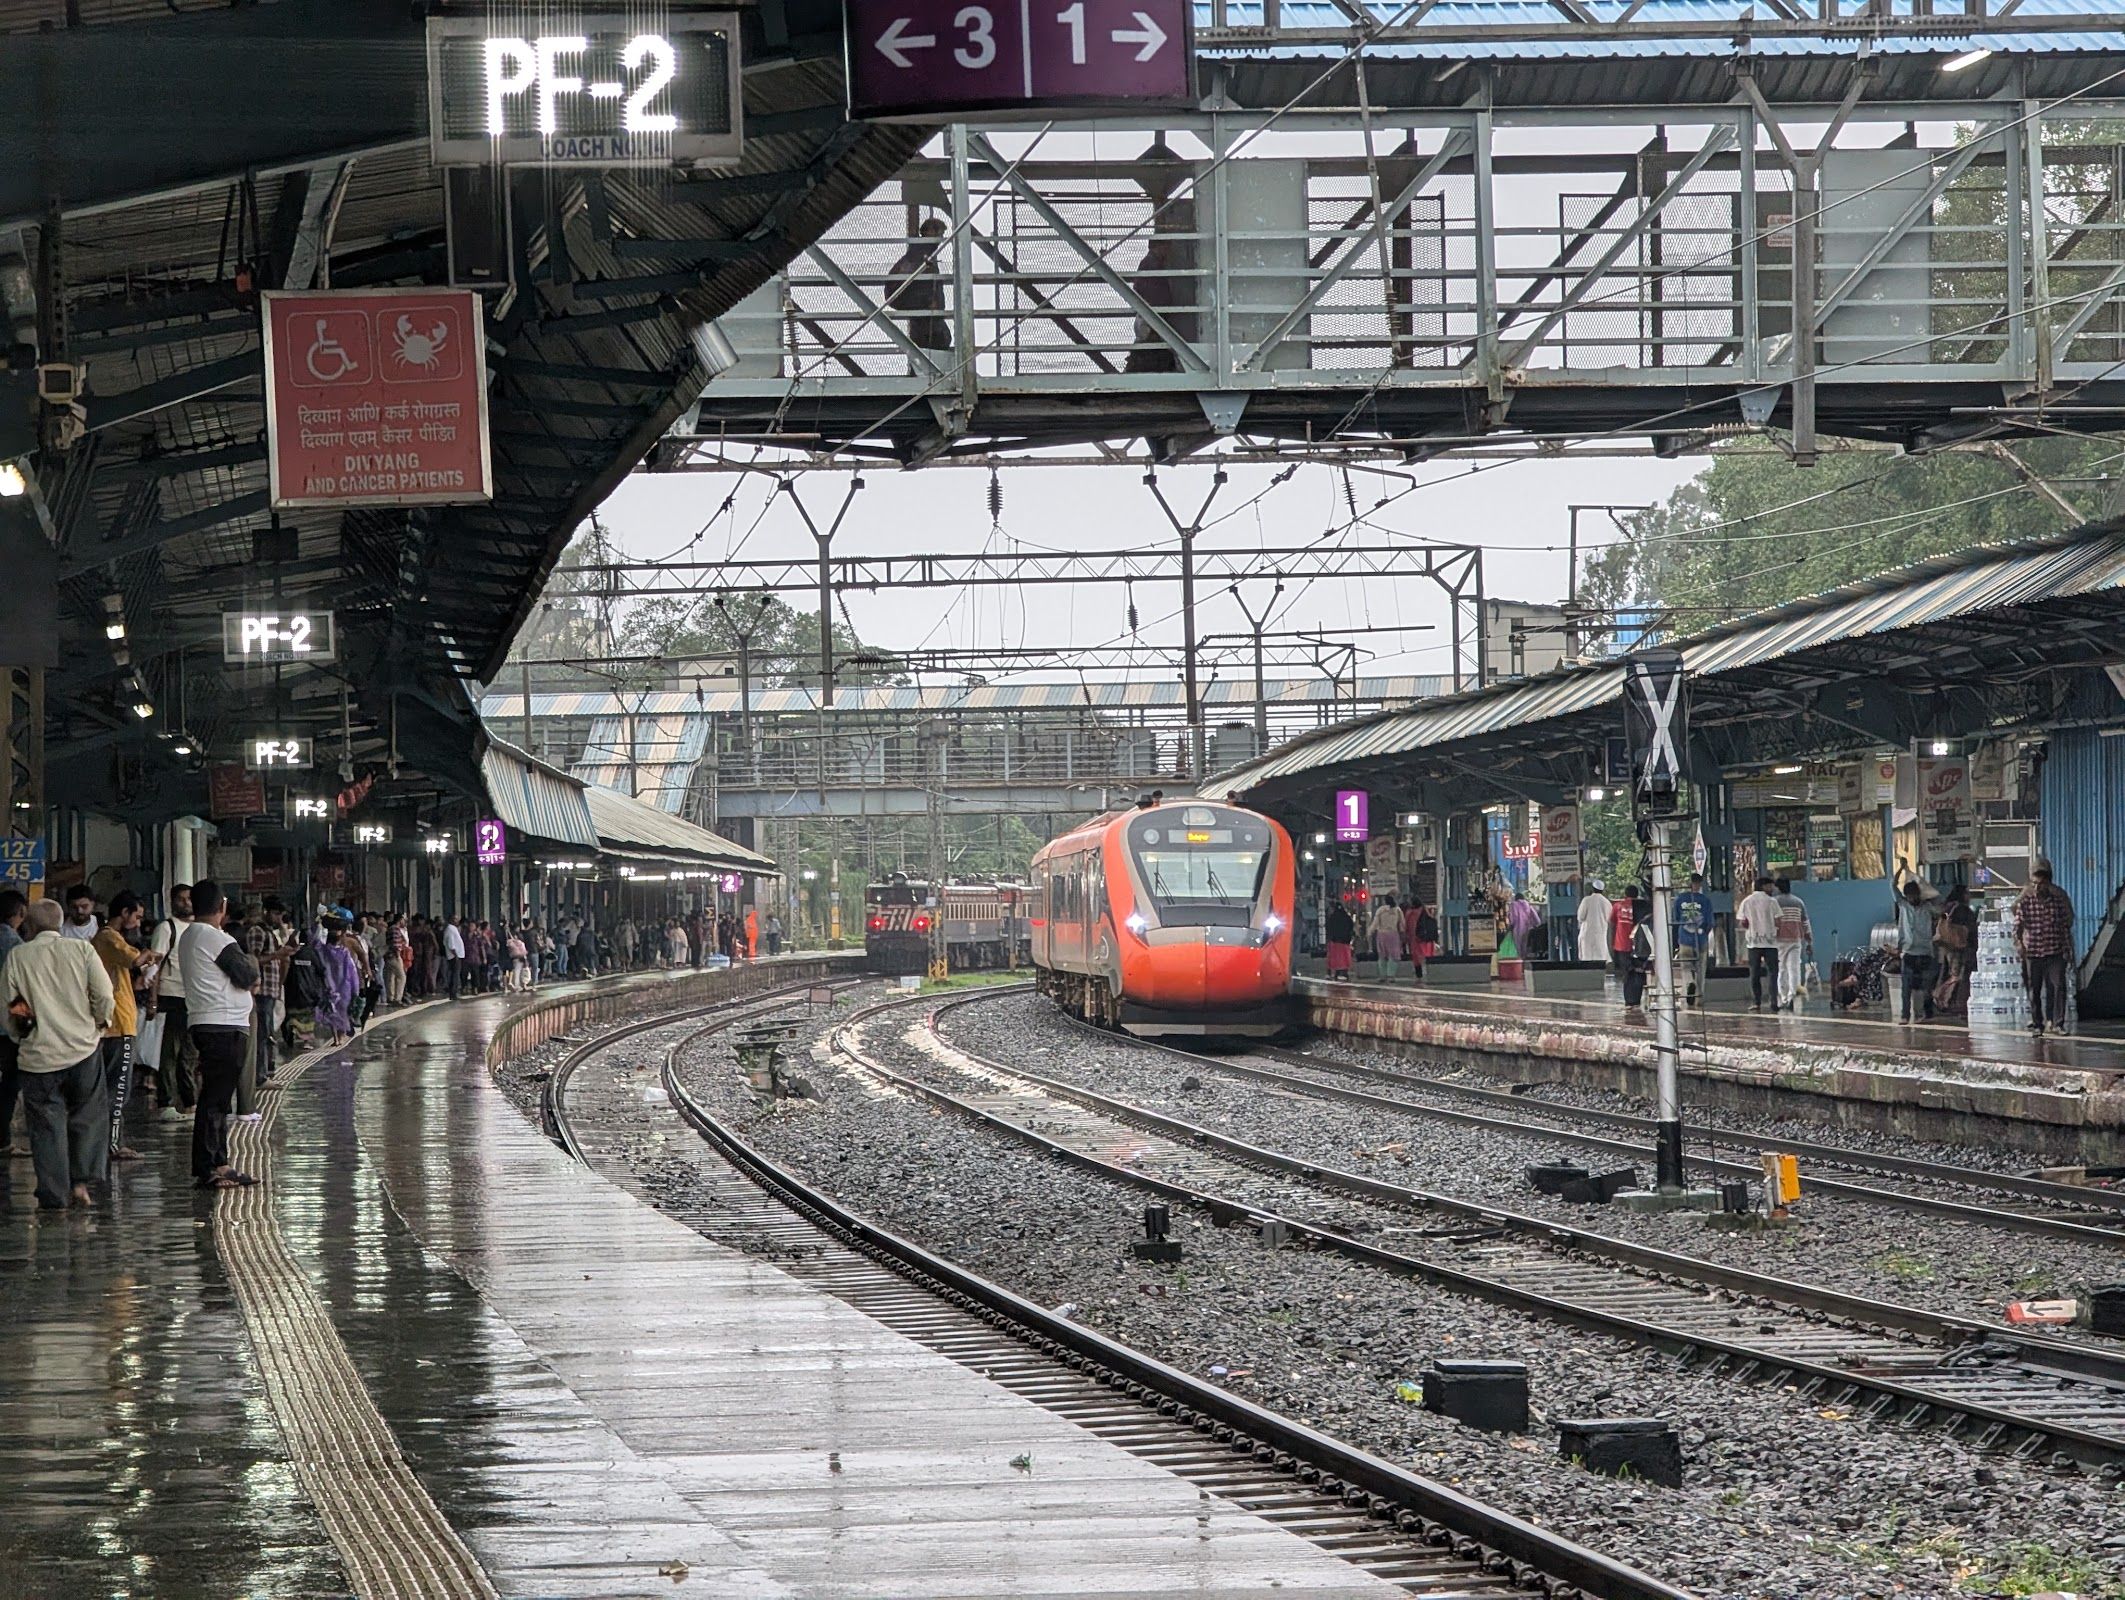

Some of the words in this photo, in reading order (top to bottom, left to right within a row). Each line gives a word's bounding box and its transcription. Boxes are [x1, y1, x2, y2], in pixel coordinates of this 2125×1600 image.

[954, 6, 996, 69] 3
[1057, 3, 1086, 64] 1
[485, 34, 677, 135] PF-2
[541, 137, 604, 158] COACH
[346, 402, 380, 422] आणि
[385, 400, 409, 421] कर्क
[348, 431, 380, 449] एवम्
[345, 453, 420, 472] DIVYANG
[306, 476, 335, 494] AND
[340, 473, 396, 492] CANCER
[400, 470, 464, 488] PATIENTS
[242, 616, 311, 653] PF-2
[255, 741, 300, 765] PF-2
[295, 799, 328, 817] PF-2
[1344, 795, 1359, 825] 1
[359, 826, 385, 842] PF-2
[480, 824, 501, 851] 2
[1, 841, 37, 858] 127
[5, 863, 31, 880] 45
[725, 874, 735, 891] 2
